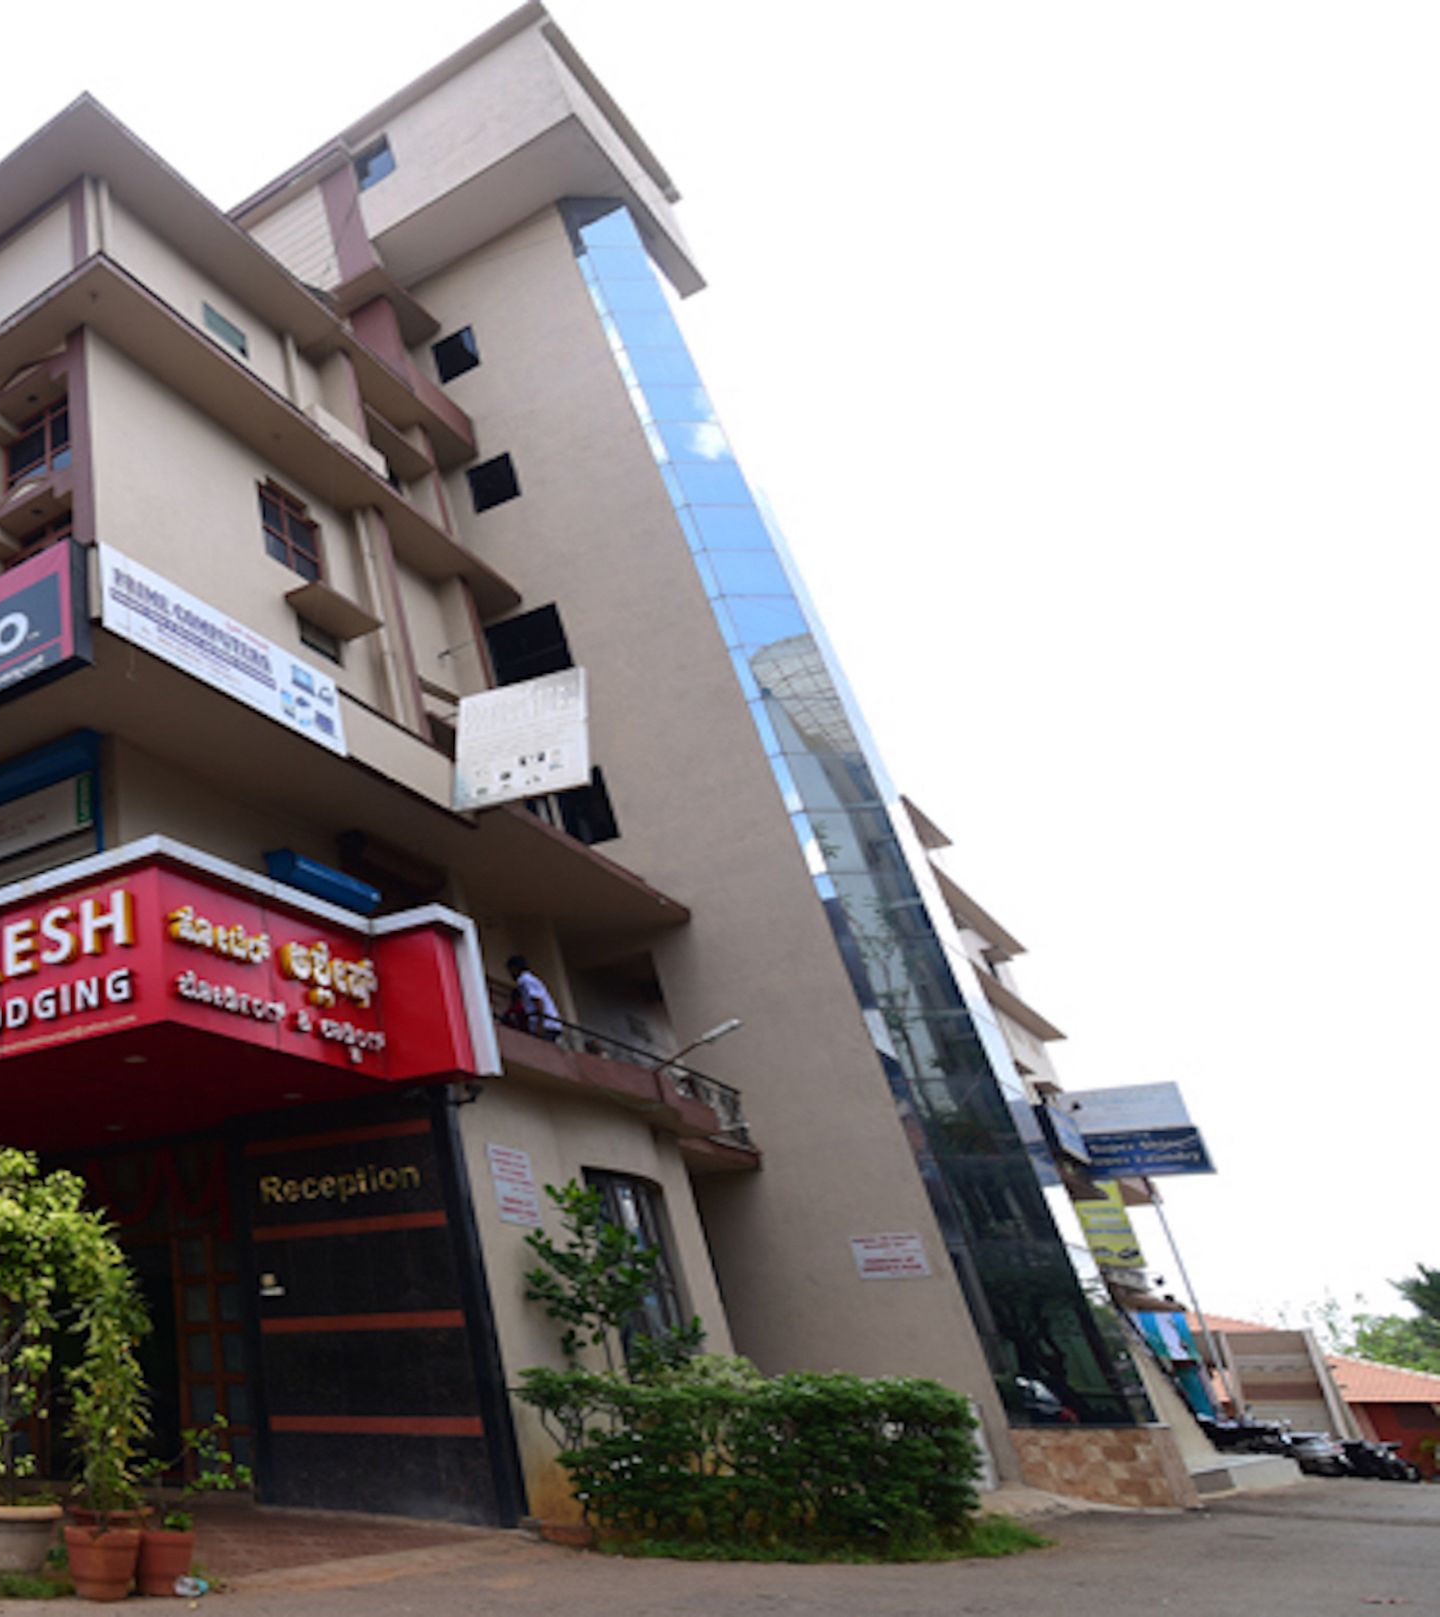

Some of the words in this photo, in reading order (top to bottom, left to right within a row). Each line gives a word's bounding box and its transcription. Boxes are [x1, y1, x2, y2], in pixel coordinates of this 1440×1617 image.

[112, 567, 172, 614] PRIME
[172, 602, 273, 674] COMPUTERS
[259, 1163, 421, 1204] Reception
